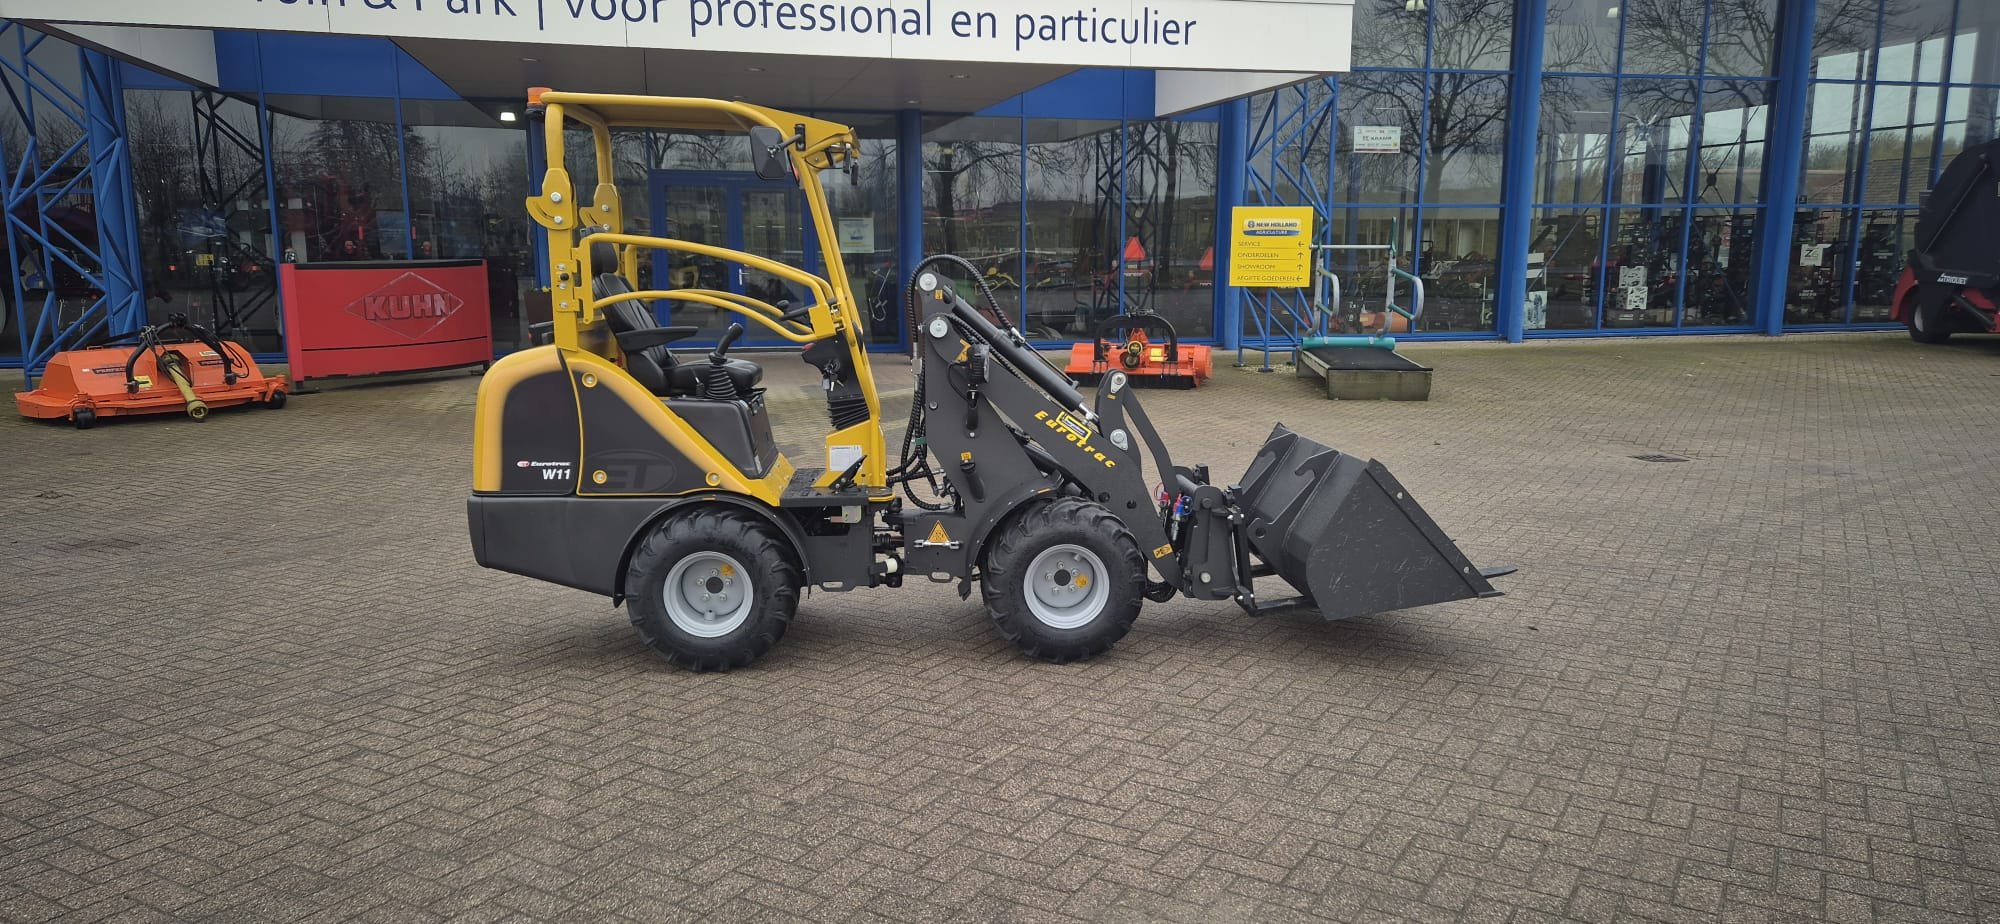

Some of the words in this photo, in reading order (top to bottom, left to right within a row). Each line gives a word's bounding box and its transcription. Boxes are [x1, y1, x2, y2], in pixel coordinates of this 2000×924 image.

[565, 0, 662, 23] voor
[689, 0, 931, 37] professional
[951, 10, 997, 39] en
[1014, 7, 1197, 51] particulier
[364, 293, 451, 320] KUHN
[1034, 410, 1116, 468] Eurotrac
[542, 468, 571, 480] W11
